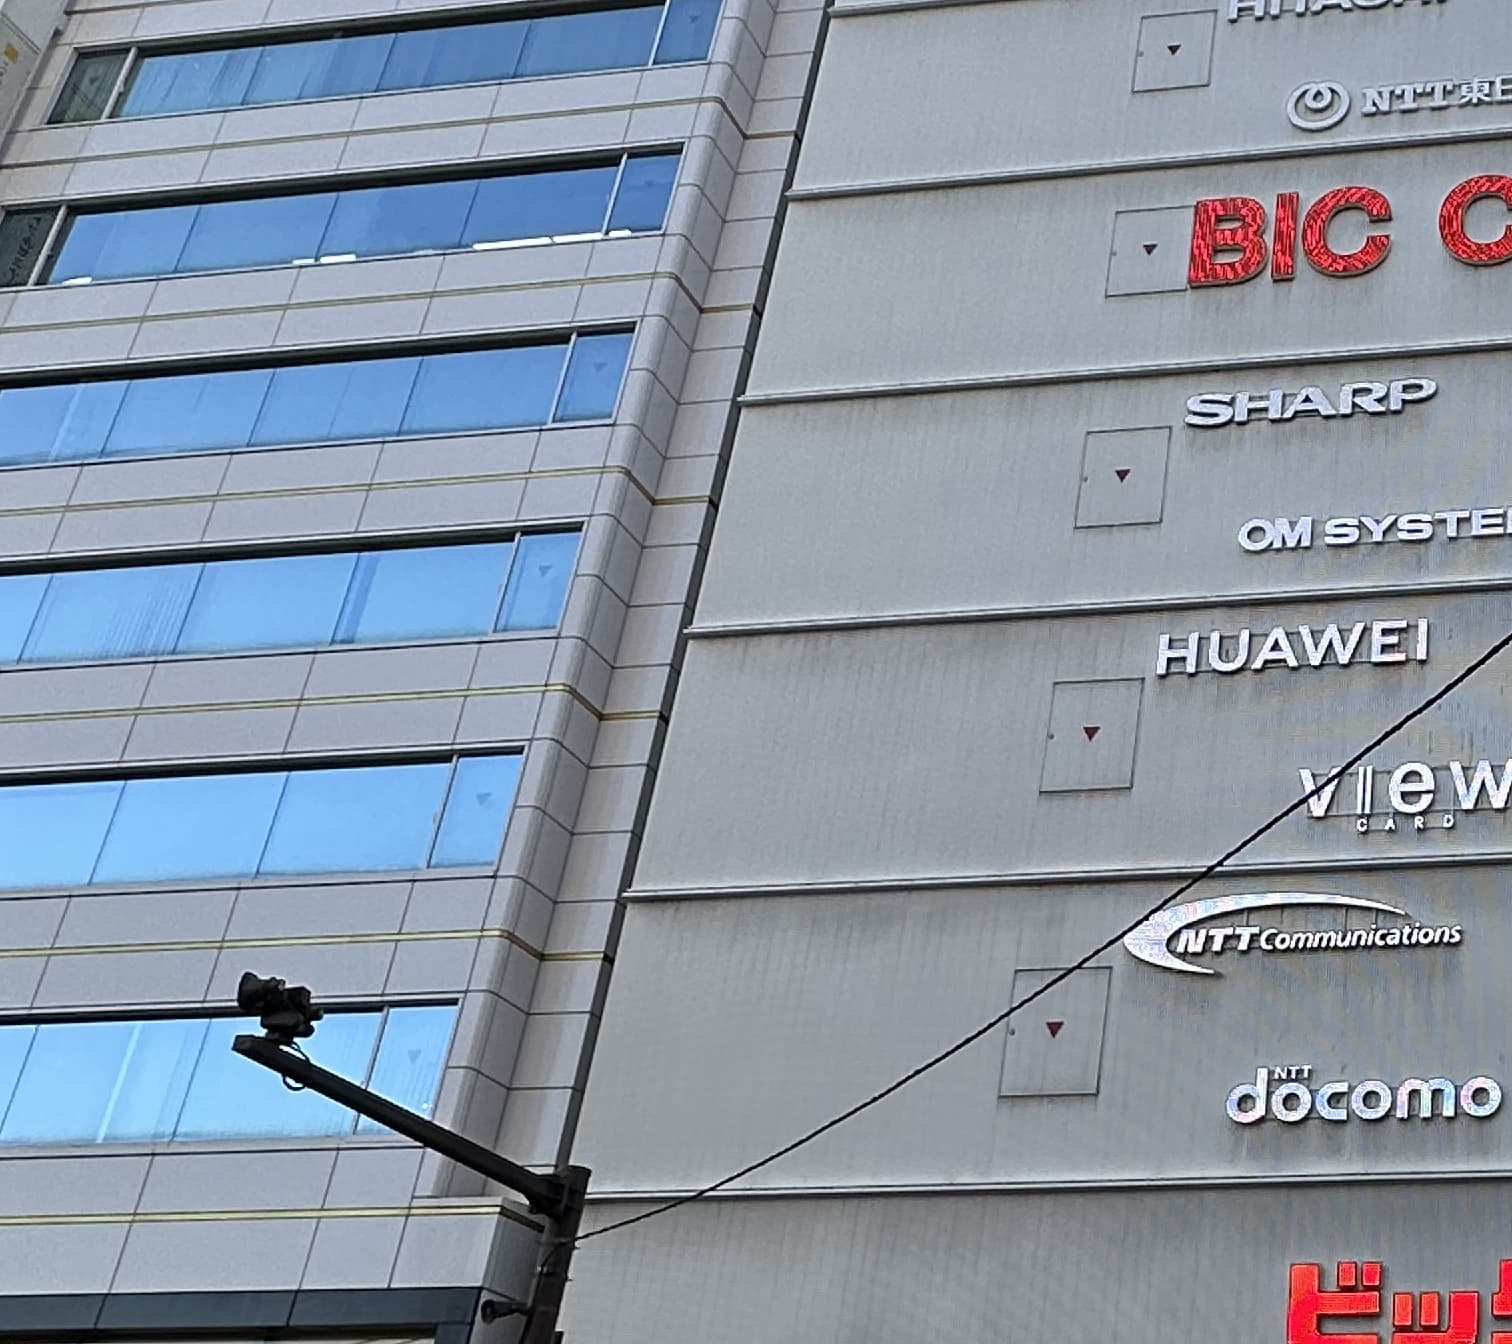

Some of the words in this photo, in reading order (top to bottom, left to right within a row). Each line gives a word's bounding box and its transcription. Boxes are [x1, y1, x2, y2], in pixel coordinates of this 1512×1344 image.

[1187, 185, 1392, 289] BIC
[1184, 377, 1438, 428] SHARP
[1237, 516, 1312, 554] OM
[1156, 619, 1430, 678] HUAWEI
[1356, 813, 1455, 833] CARD
[1177, 925, 1259, 955] NTT
[1260, 921, 1463, 953] Communications
[1273, 1063, 1312, 1080] NTT
[1225, 1066, 1503, 1125] docomo
